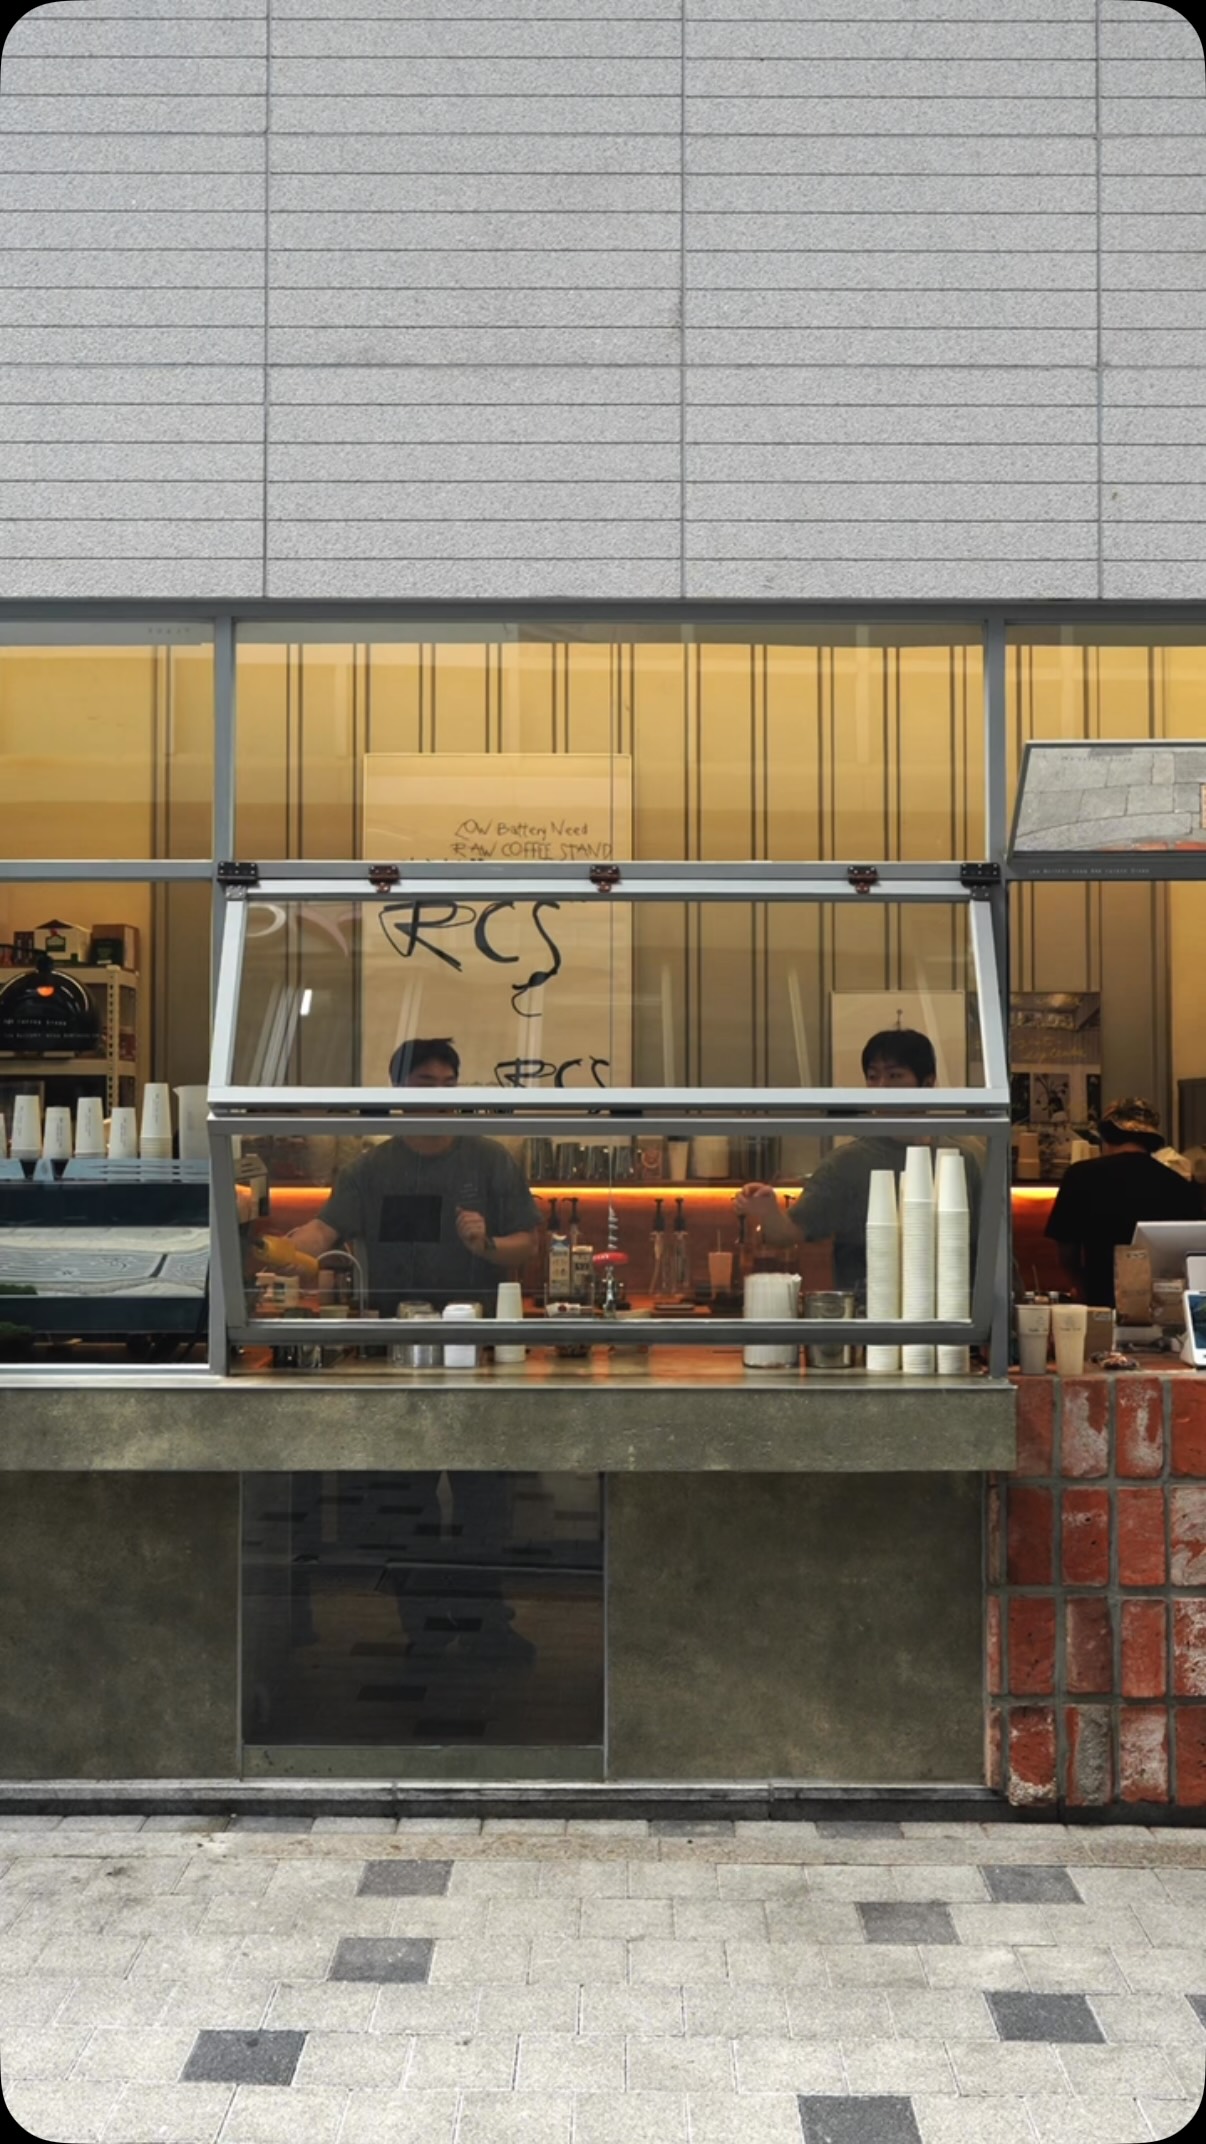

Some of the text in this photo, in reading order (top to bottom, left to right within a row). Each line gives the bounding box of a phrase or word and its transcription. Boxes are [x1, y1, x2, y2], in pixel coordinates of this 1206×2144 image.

[497, 822, 547, 841] Battery
[550, 819, 588, 836] Need
[451, 840, 613, 861] RAW COFFEE STAND
[379, 900, 562, 1016] RCS
